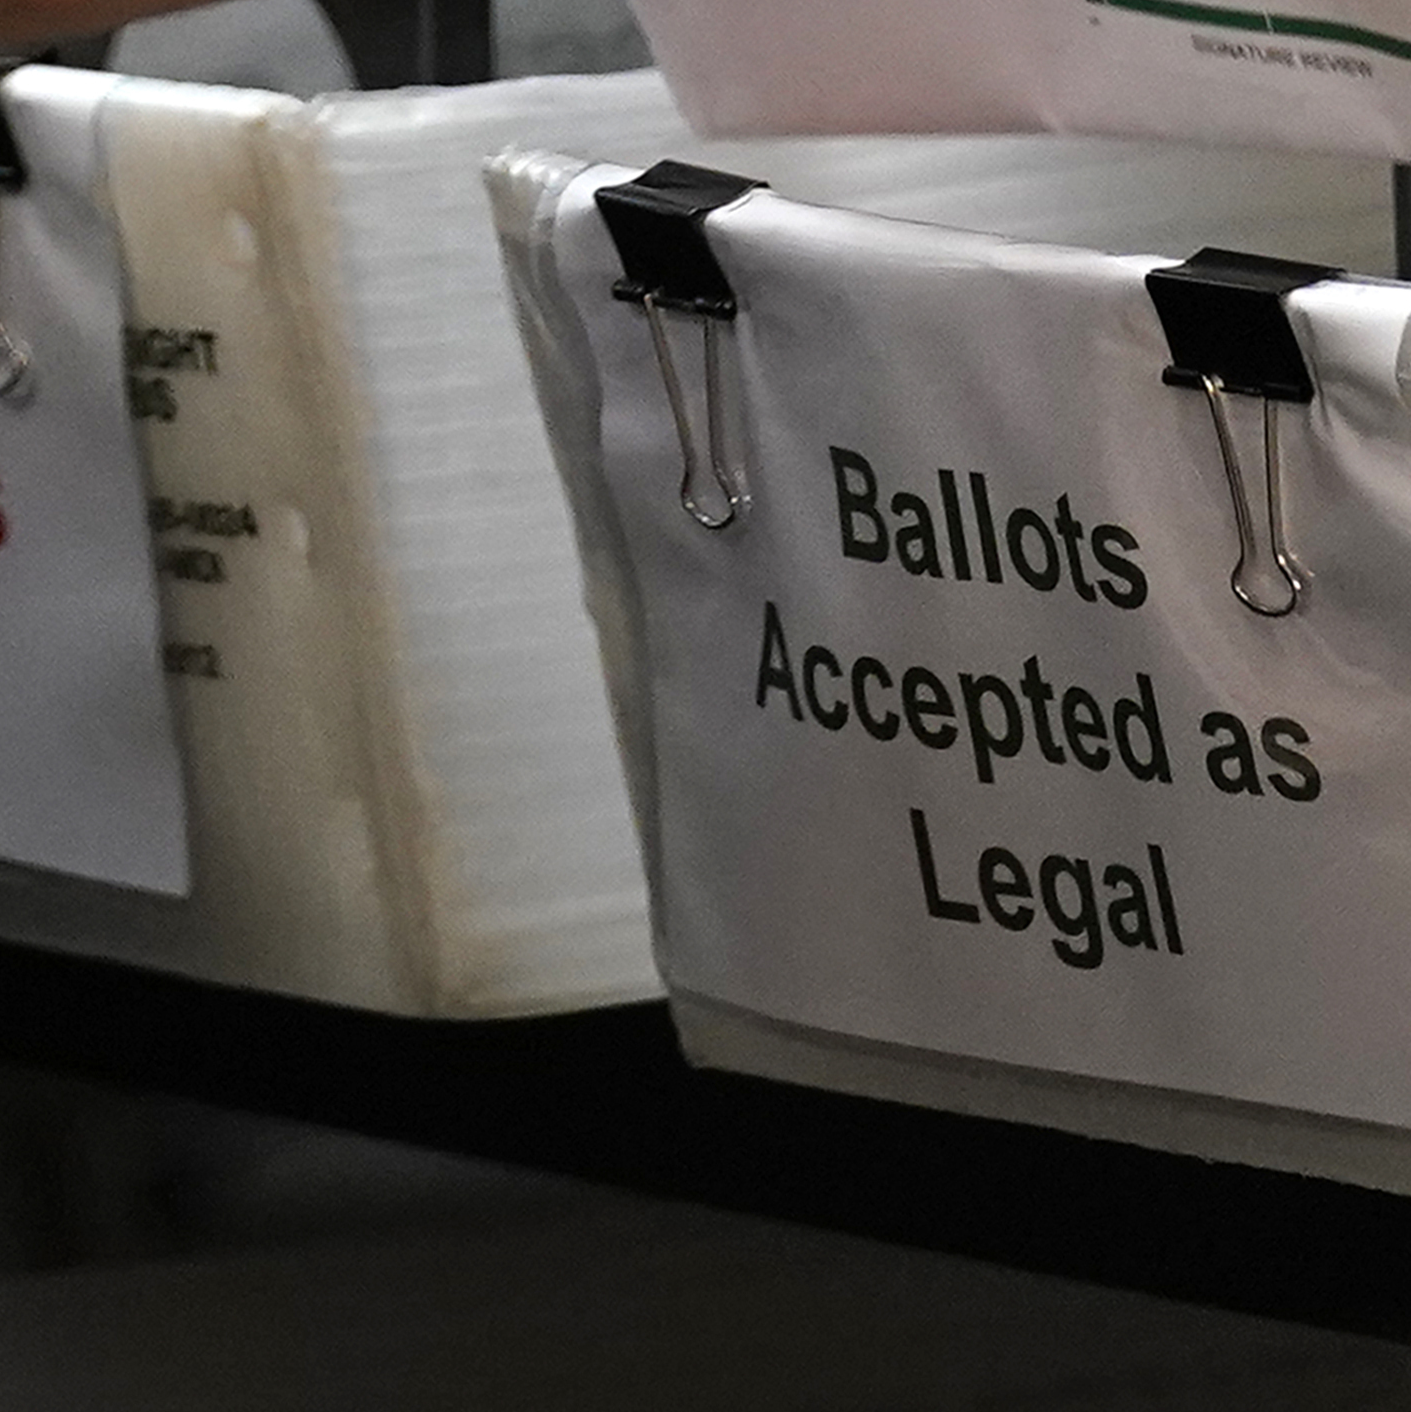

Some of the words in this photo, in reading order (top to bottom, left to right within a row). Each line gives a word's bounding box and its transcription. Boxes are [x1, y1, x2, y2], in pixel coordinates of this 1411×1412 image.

[829, 446, 1150, 610] Ballots
[756, 600, 1174, 786] Accepted
[1200, 708, 1324, 803] as
[909, 806, 1185, 970] Legal
